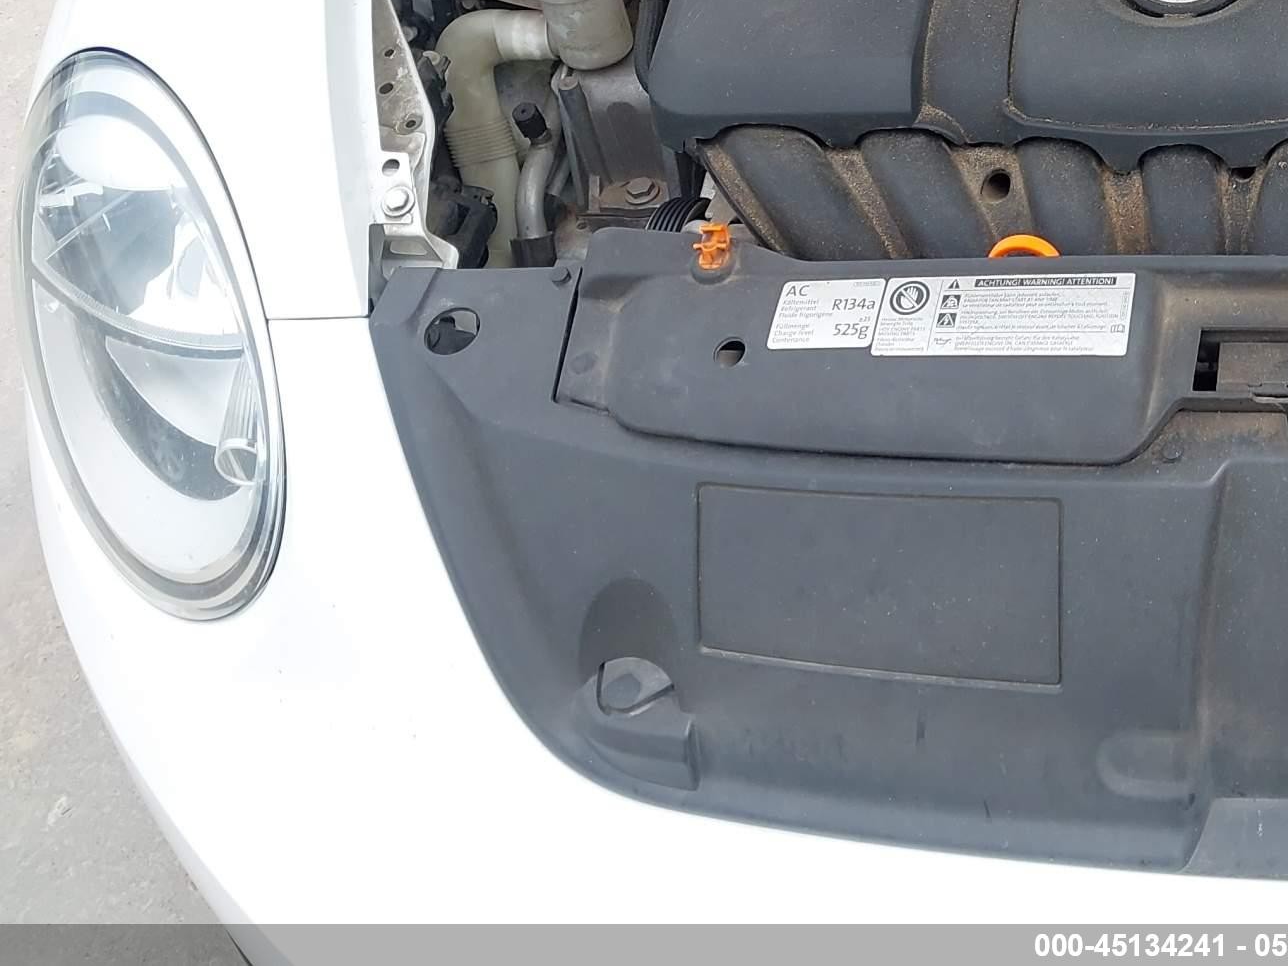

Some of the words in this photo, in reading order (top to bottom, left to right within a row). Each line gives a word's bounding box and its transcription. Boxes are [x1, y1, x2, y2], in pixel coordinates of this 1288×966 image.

[977, 279, 1021, 287] ACHTUNG!
[1023, 278, 1064, 286] WARNING!
[1066, 277, 1114, 285] ATTENTION!
[786, 285, 810, 297] AC
[832, 298, 876, 311] R134a
[833, 323, 870, 340] 525g
